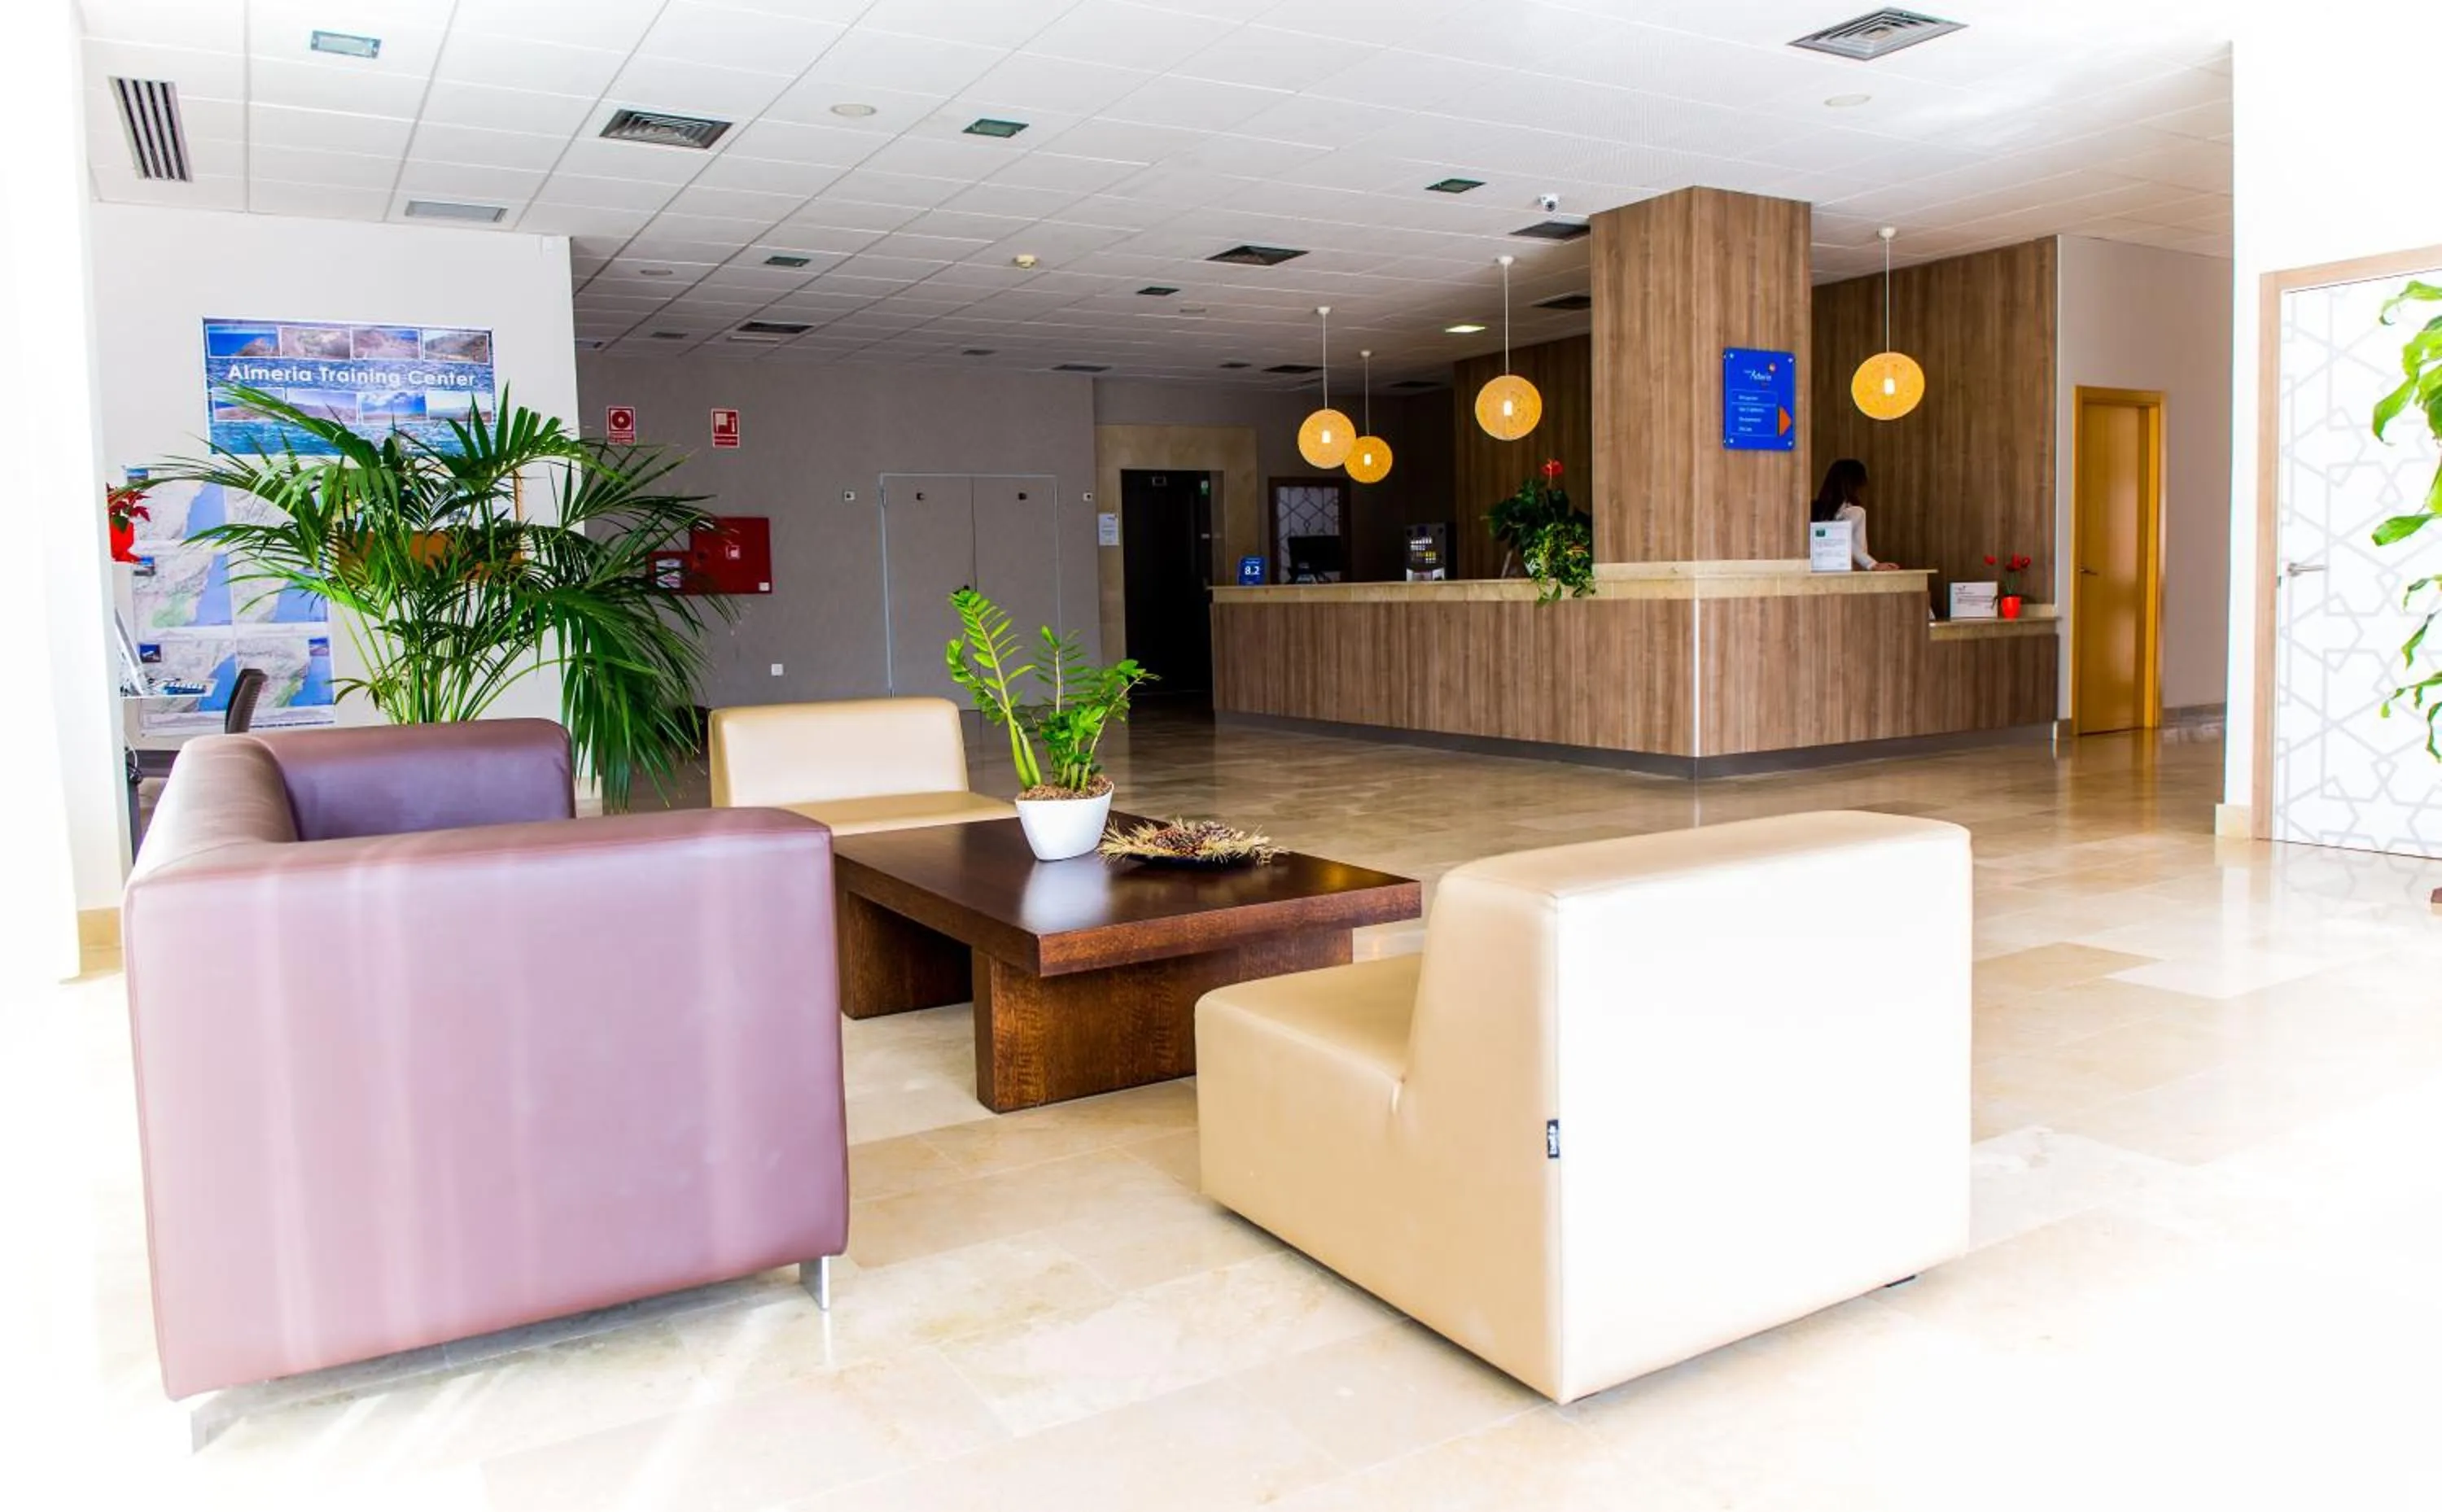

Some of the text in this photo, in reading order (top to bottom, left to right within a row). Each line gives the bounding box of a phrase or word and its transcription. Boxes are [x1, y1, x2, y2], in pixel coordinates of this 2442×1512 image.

[228, 363, 477, 388] Almeria Training Center
[1245, 566, 1260, 575] 8.2
